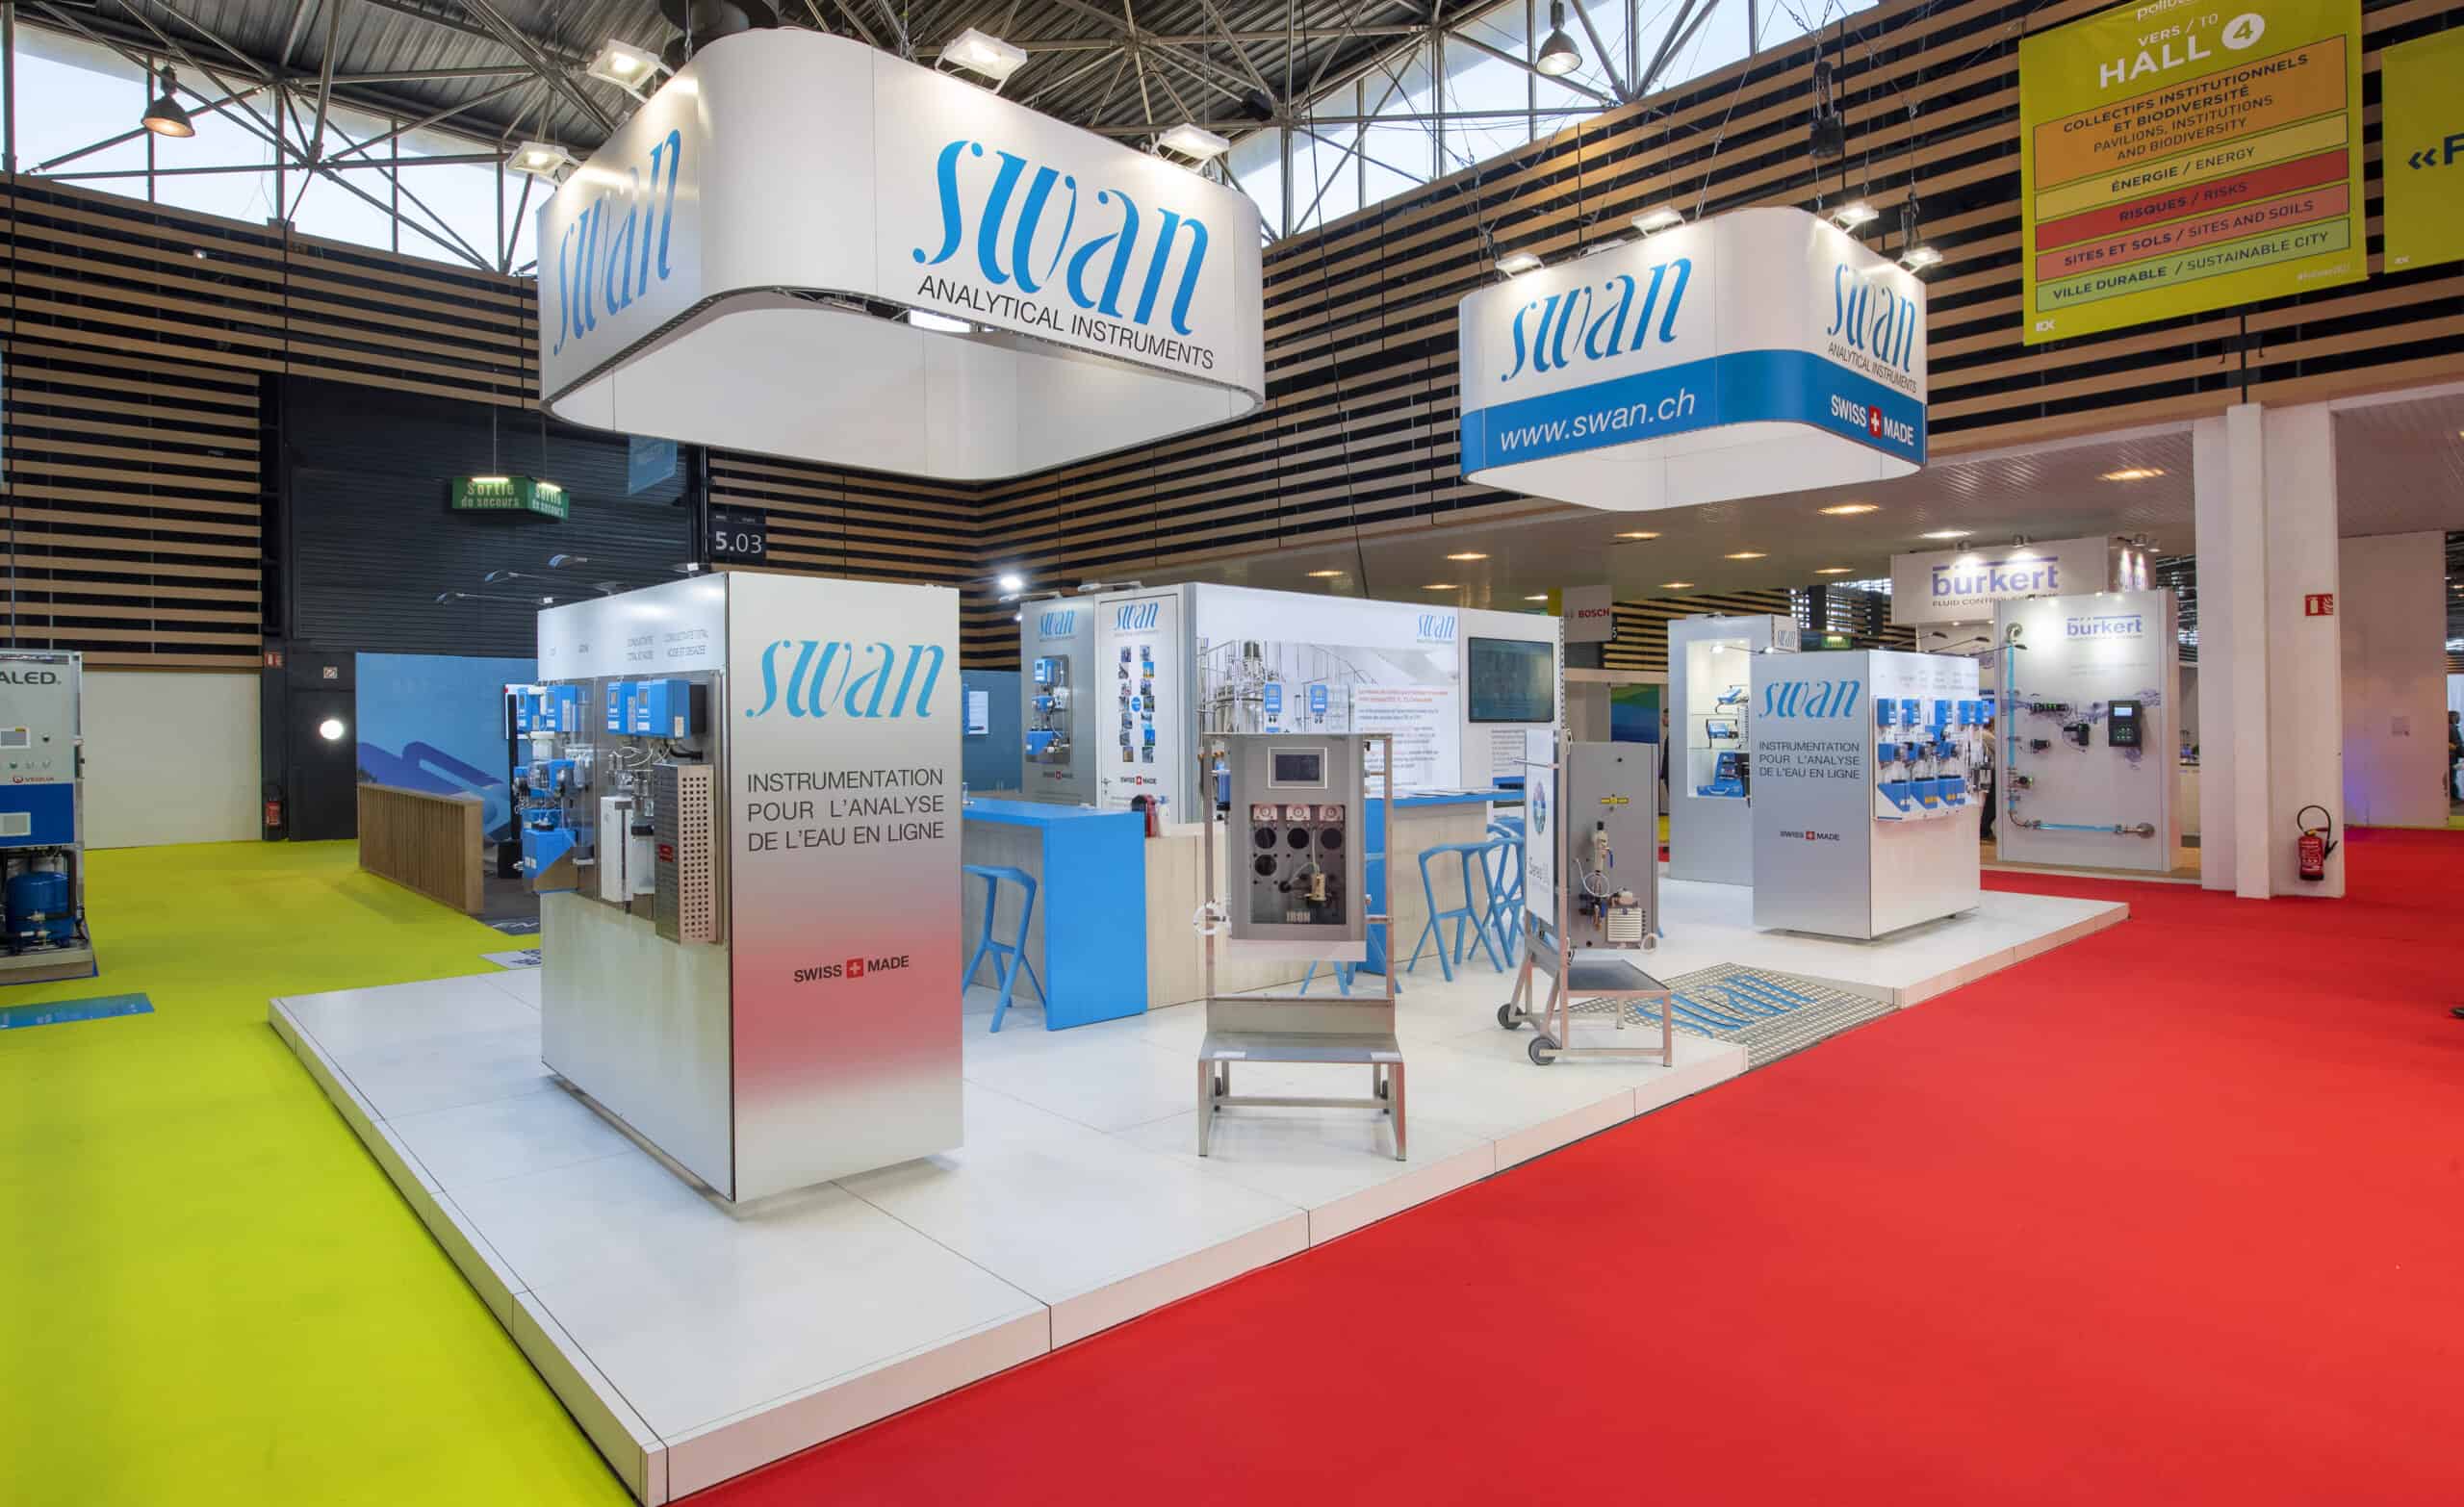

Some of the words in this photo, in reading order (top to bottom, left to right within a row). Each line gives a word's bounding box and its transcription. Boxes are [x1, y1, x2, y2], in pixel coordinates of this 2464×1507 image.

[2138, 24, 2181, 46] VERS
[2199, 13, 2219, 29] TO
[2099, 35, 2212, 89] HALL
[2231, 18, 2254, 41] 4
[2064, 97, 2156, 133] COLLECTIFS
[2160, 53, 2309, 106] INSTITUTIONNELS
[2113, 119, 2133, 133] ET
[2137, 85, 2249, 127] BIODIVERSITÉ
[2093, 125, 2169, 153] PAVILIONS,
[2172, 95, 2272, 132] INSTITUTIONS
[2118, 144, 2146, 161] AND
[2150, 117, 2247, 152] BIODIVERSITY
[2111, 165, 2178, 192] ÉNERGIE
[2195, 146, 2255, 170] ENERGY
[2119, 195, 2187, 221] RISQUES
[2203, 181, 2248, 202] RISKS
[552, 129, 681, 357] swan
[911, 139, 1210, 337] swan
[2064, 248, 2104, 267] SITES
[2109, 243, 2127, 256] ET
[2132, 233, 2172, 250] SOLS
[2188, 219, 2229, 238] SITES
[2233, 211, 2265, 227] AND
[2269, 200, 2314, 219] SOILS
[2052, 283, 2092, 300] VILLE
[2095, 267, 2168, 291] DURABLE
[2187, 239, 2292, 271] SUSTAINABLE
[2295, 231, 2329, 248] CITY
[918, 275, 1065, 333] ANALYTICAL
[1071, 313, 1216, 370] INSTRUMENTS
[1501, 257, 1692, 383] swan
[1827, 262, 1916, 373] swan
[1828, 341, 1872, 376] ANALYTICAL
[1872, 360, 1917, 394] INSTRUMENTS
[1501, 387, 1696, 451] www.swan.ch
[1831, 396, 1867, 429] SWISS
[1884, 418, 1914, 447] MADE
[715, 531, 762, 553] 5.03
[1578, 607, 1610, 618] BOSCH
[745, 639, 945, 718] swan
[1758, 679, 1861, 719] swan
[1758, 741, 1860, 753] INSTRUMENTATION
[1759, 754, 1791, 764] POUR
[1798, 754, 1860, 766] L'ANALYSE
[748, 768, 943, 793] INSTRUMENTATION
[1759, 767, 1774, 778] DE
[1777, 767, 1807, 778] L'EAU
[1810, 768, 1823, 779] EN
[1828, 768, 1860, 779] LIGNE
[748, 801, 814, 822] POUR
[831, 795, 944, 818] L'ANALYSE
[749, 832, 779, 852] DE
[785, 829, 845, 849] L'EAU
[854, 826, 881, 844] EN
[887, 822, 944, 842] LIGNE
[1816, 831, 1840, 841] MADE
[793, 963, 842, 983] SWISS
[867, 956, 910, 972] MADE
